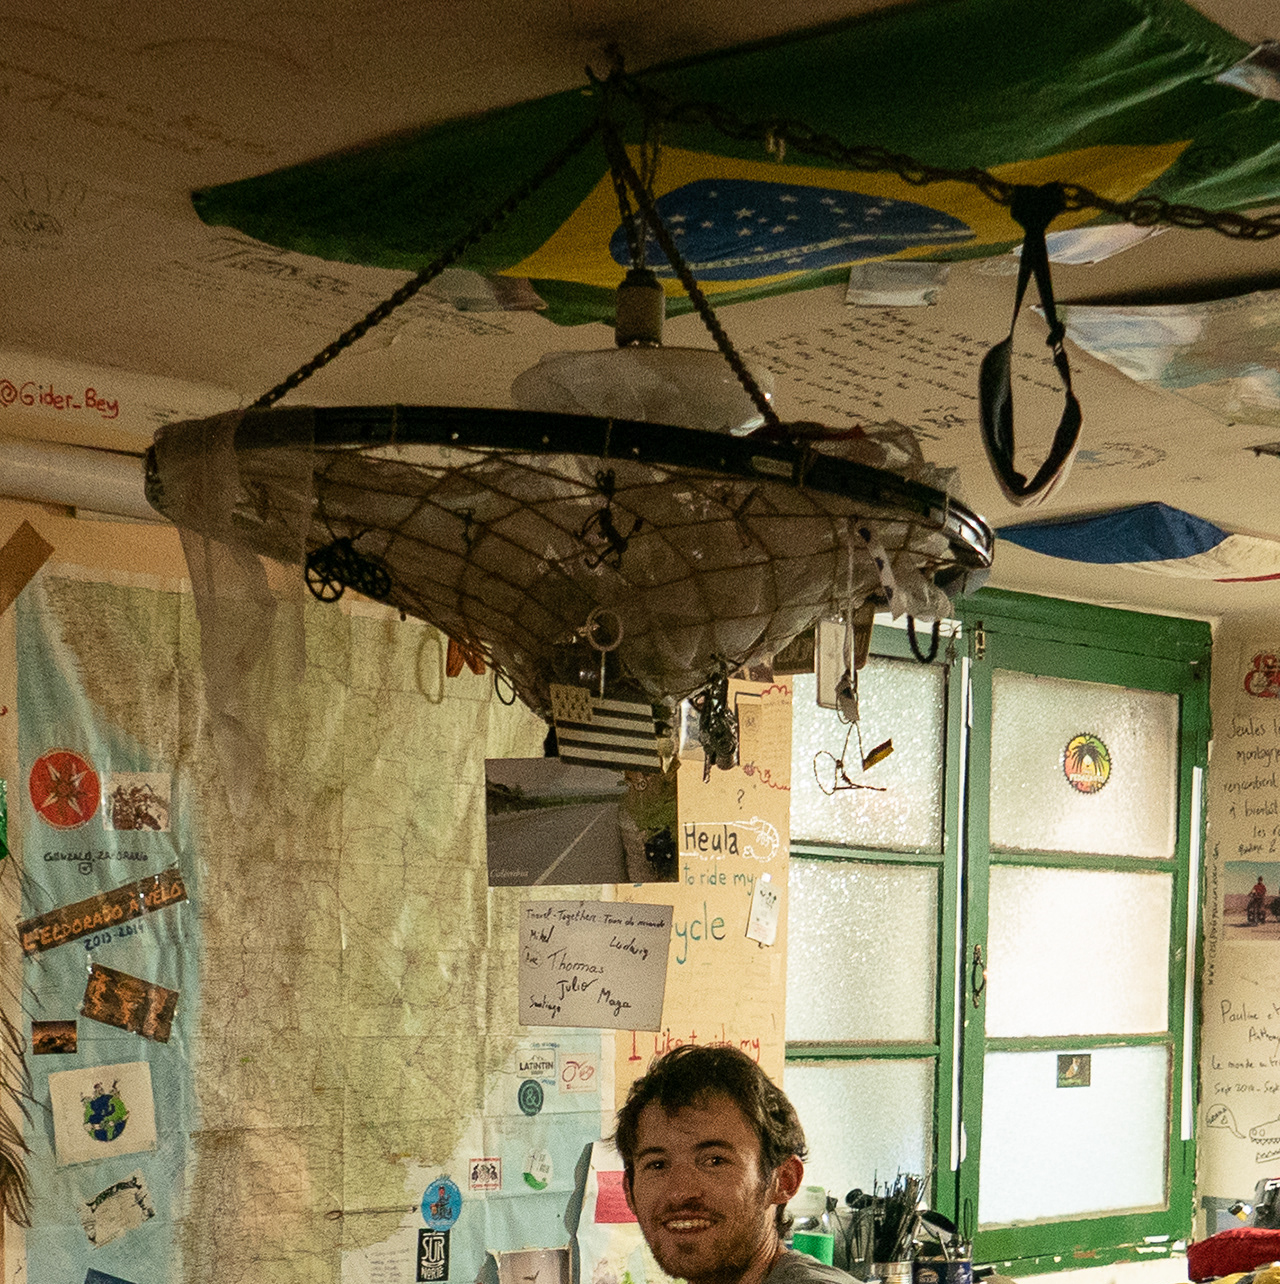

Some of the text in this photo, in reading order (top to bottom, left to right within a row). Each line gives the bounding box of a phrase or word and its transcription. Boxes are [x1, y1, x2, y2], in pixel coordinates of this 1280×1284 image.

[700, 867, 726, 886] ride
[548, 946, 604, 974] Thomas
[1220, 999, 1260, 1024] Pauline
